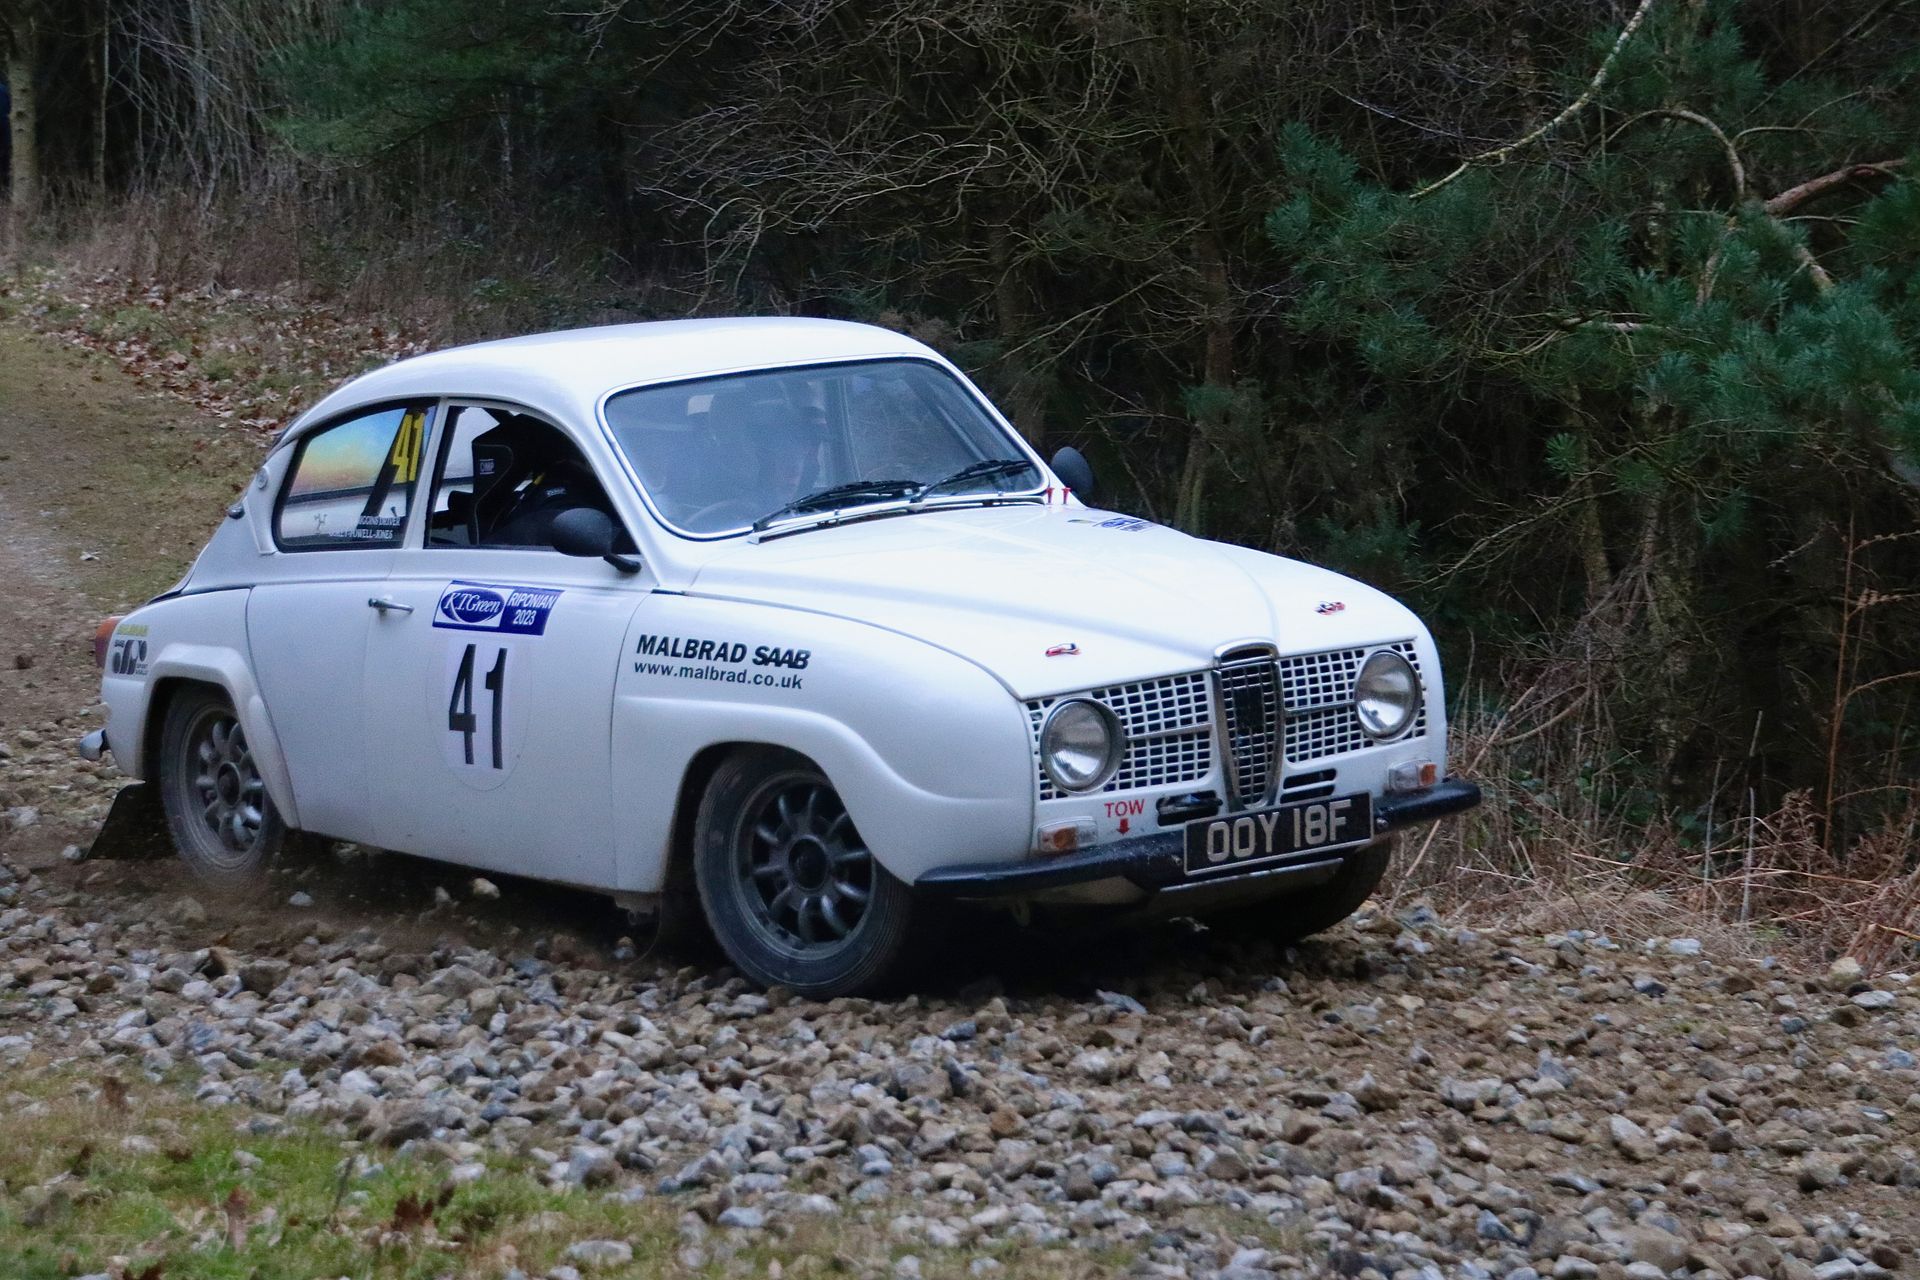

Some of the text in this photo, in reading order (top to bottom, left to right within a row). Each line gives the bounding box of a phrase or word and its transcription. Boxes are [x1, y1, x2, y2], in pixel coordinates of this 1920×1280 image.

[392, 412, 425, 484] 41
[507, 592, 556, 609] RIPONIAN
[513, 609, 537, 626] 2023
[636, 634, 811, 670] MALBRAD SAAB
[634, 661, 803, 690] www.malbrad.co.uk
[448, 643, 508, 770] 41
[1104, 798, 1145, 818] TOW
[1207, 799, 1352, 863] OOY 18F
